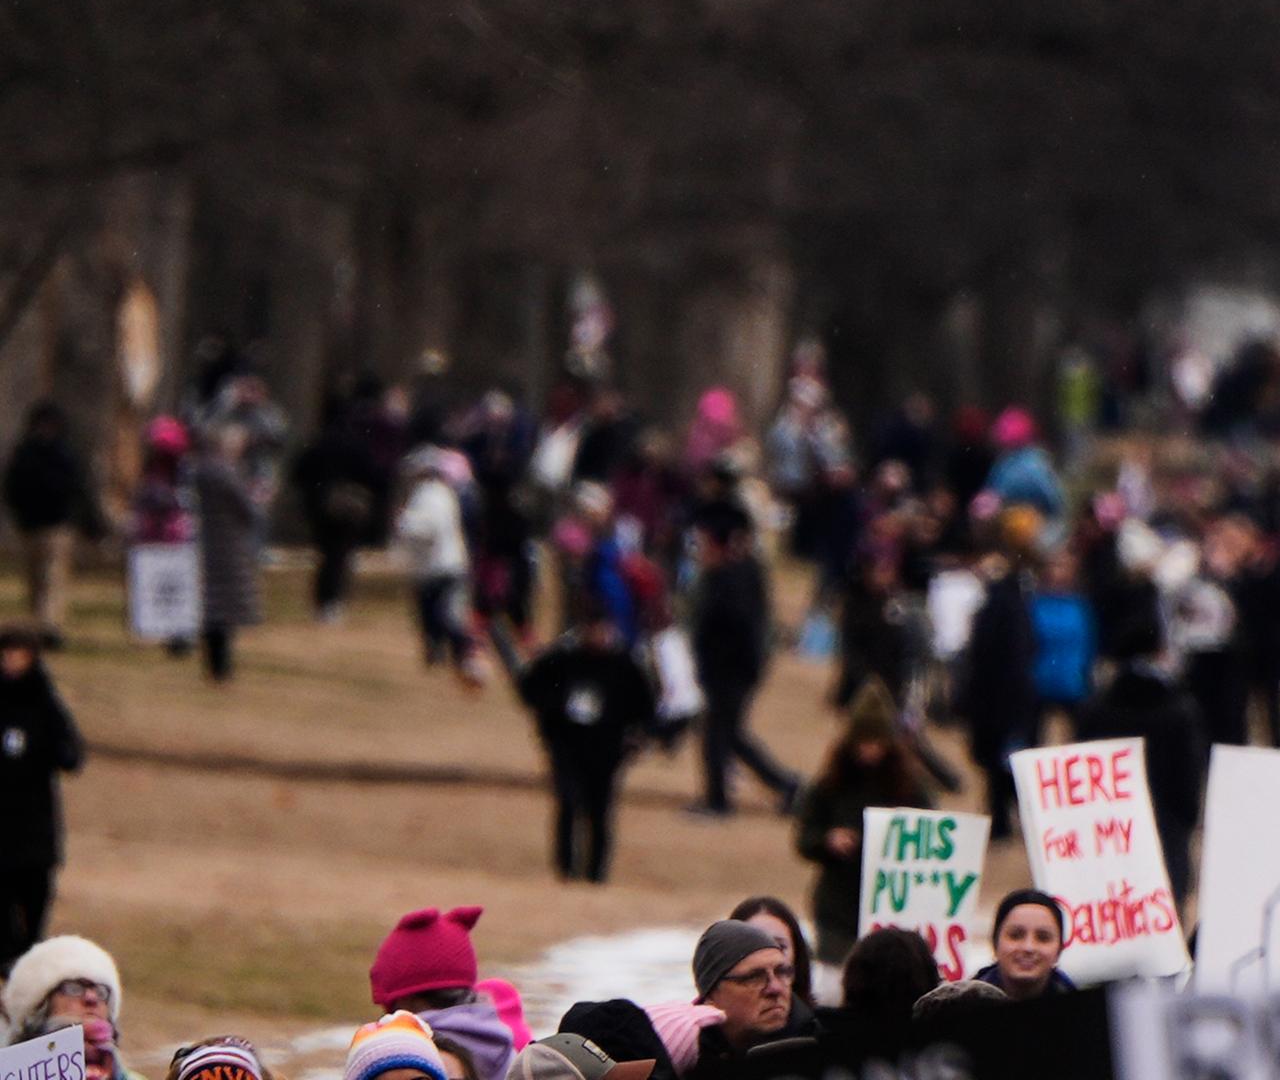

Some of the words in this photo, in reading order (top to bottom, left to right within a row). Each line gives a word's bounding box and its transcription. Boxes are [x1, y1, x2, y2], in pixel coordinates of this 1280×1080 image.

[1037, 749, 1133, 810] HERE
[882, 815, 958, 862] THIS
[1094, 819, 1133, 857] MY
